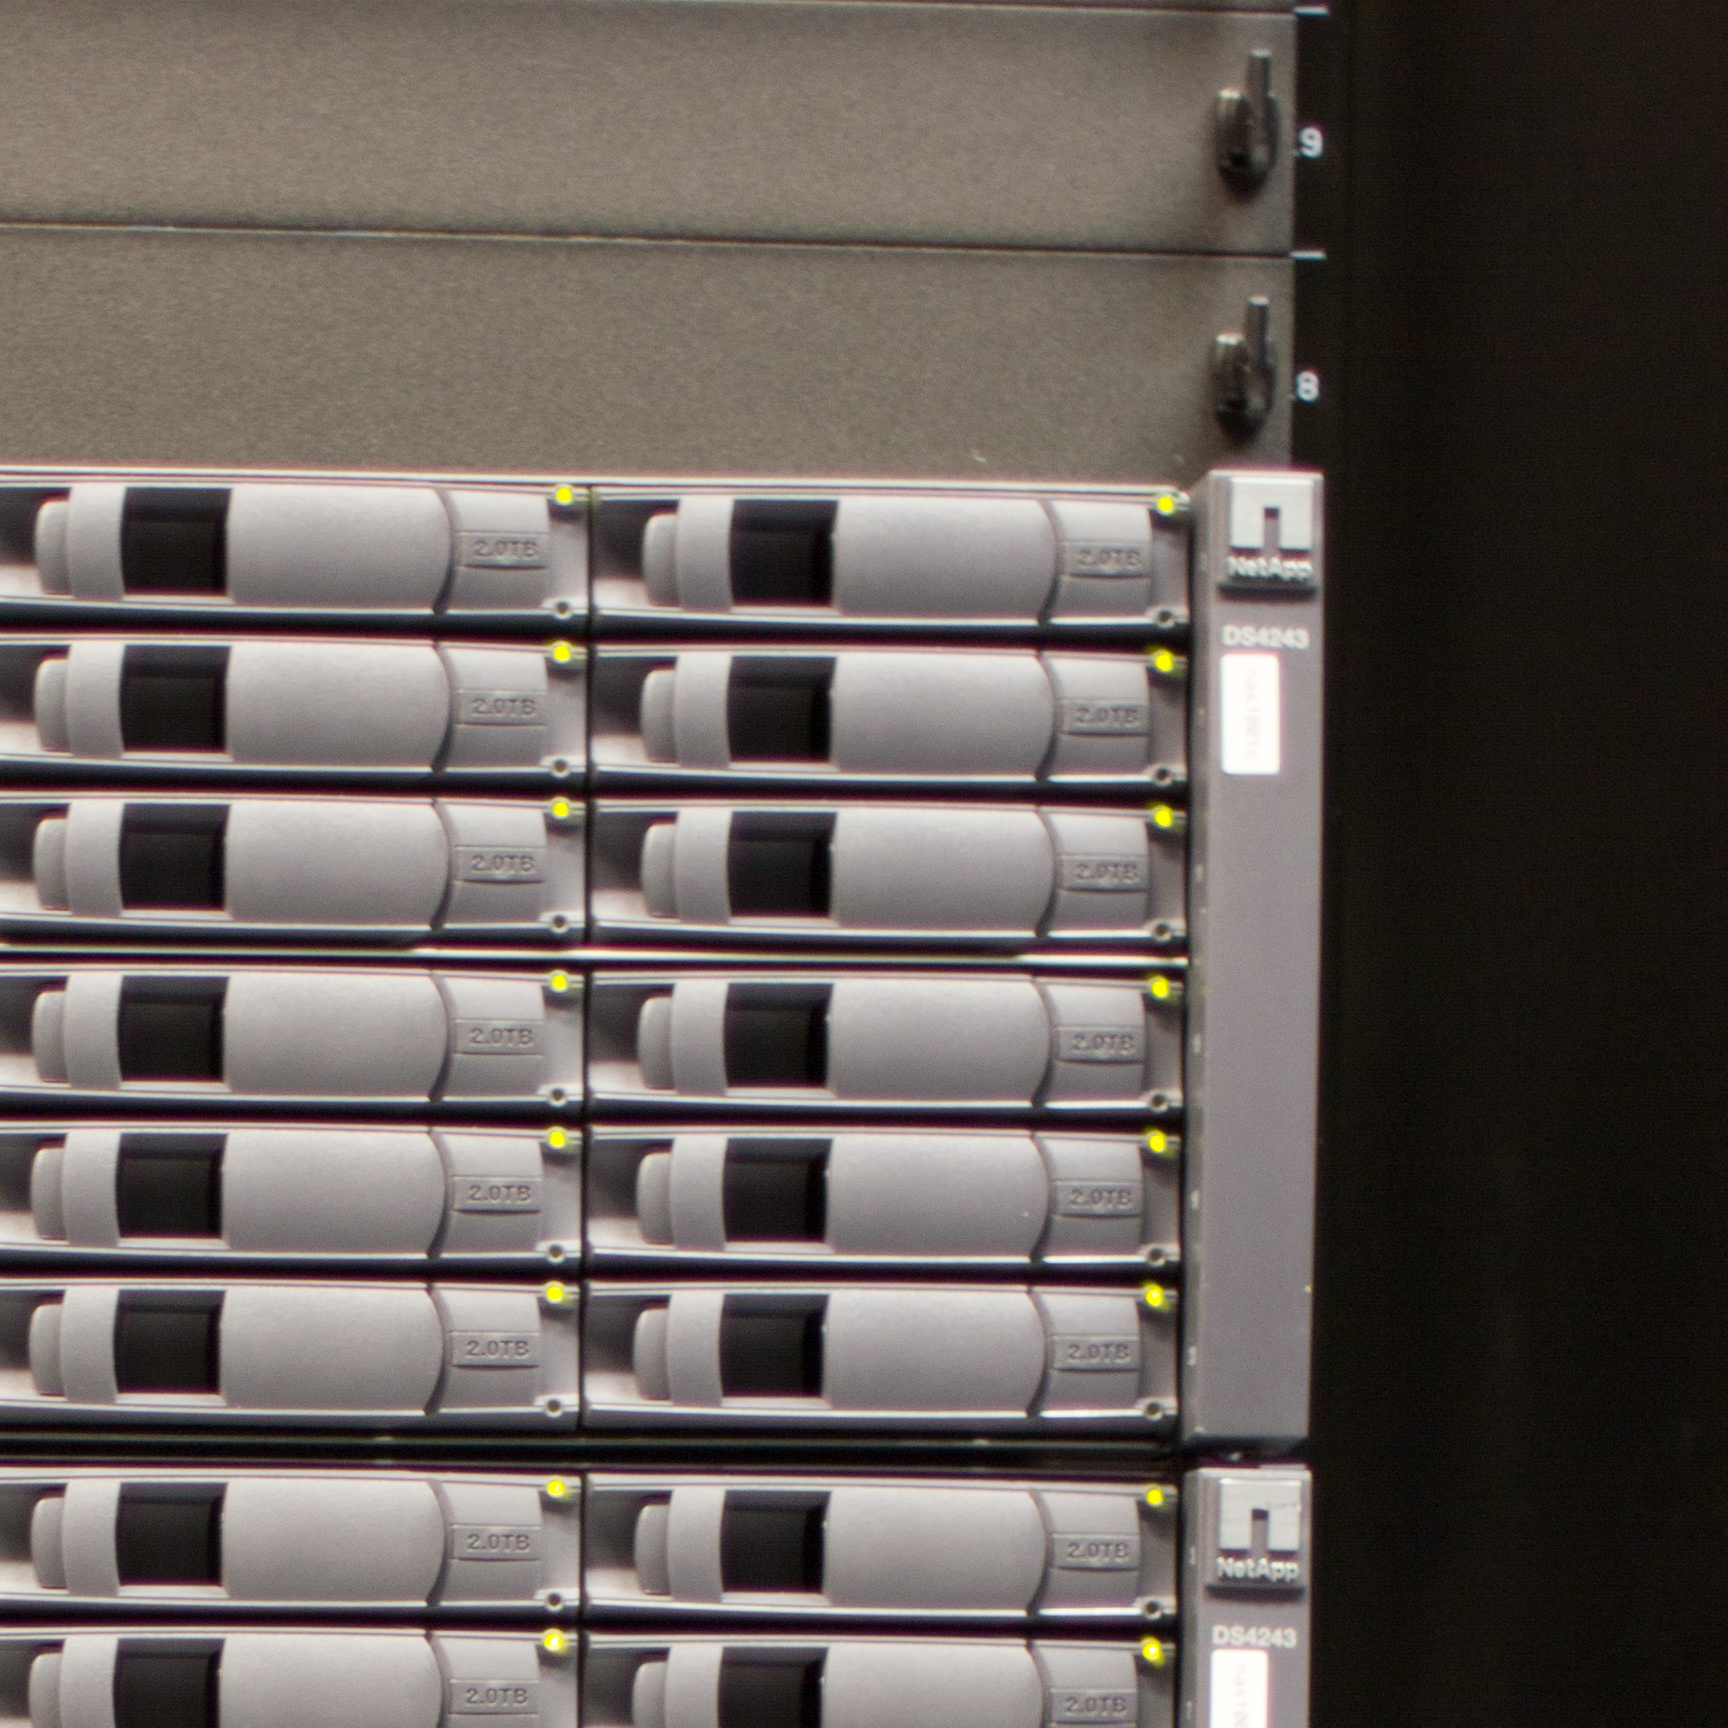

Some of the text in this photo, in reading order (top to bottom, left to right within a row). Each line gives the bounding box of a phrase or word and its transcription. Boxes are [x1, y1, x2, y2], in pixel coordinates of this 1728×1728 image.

[473, 538, 538, 557] 2.0TB
[1228, 556, 1313, 581] NetApp
[1223, 624, 1310, 650] DS4243
[472, 696, 537, 715] 2.0TB
[470, 853, 535, 872] 2.0TB
[470, 1026, 535, 1045] 2.0TB
[467, 1183, 532, 1202] 2.0TB
[465, 1338, 530, 1358] 2.0TB
[467, 1531, 532, 1551] 2.0TB
[1216, 1556, 1300, 1584] NetApp
[1211, 1625, 1298, 1650] DS4243
[464, 1686, 529, 1705] 2.0TB
